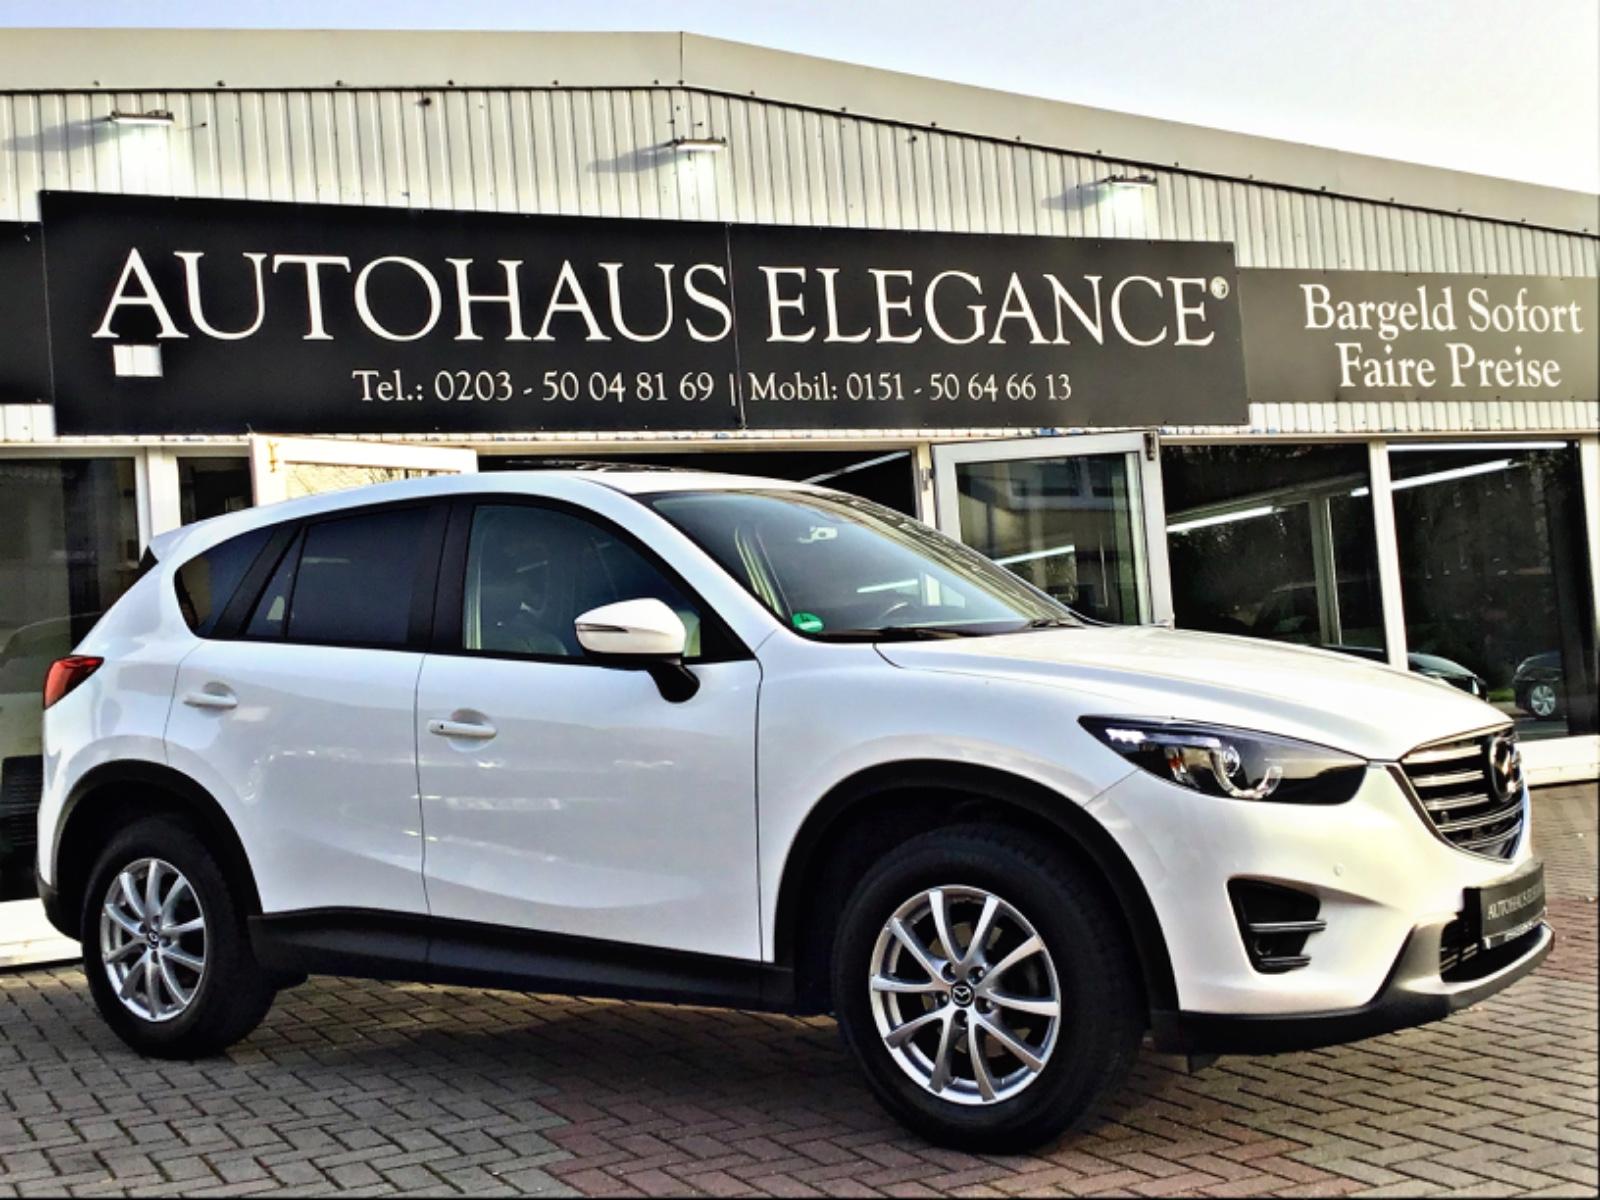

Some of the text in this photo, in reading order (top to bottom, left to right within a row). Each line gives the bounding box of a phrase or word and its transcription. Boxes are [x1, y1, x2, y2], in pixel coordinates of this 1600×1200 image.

[91, 247, 1216, 348] AUTOHAUS ELEGANCE
[1299, 283, 1587, 341] Bargeld Sofort
[351, 369, 423, 401] Tel.:
[434, 370, 513, 401] 0203
[542, 370, 580, 401] 50
[588, 371, 626, 403] 04
[636, 371, 668, 401] 81
[679, 371, 715, 401] 69
[747, 371, 838, 401] Mobil:
[846, 371, 905, 401] 0151
[930, 372, 960, 401] 50
[967, 372, 999, 402] 64
[1005, 372, 1037, 401] 66
[1045, 373, 1072, 401] 13
[1334, 342, 1562, 388] Faire Preise
